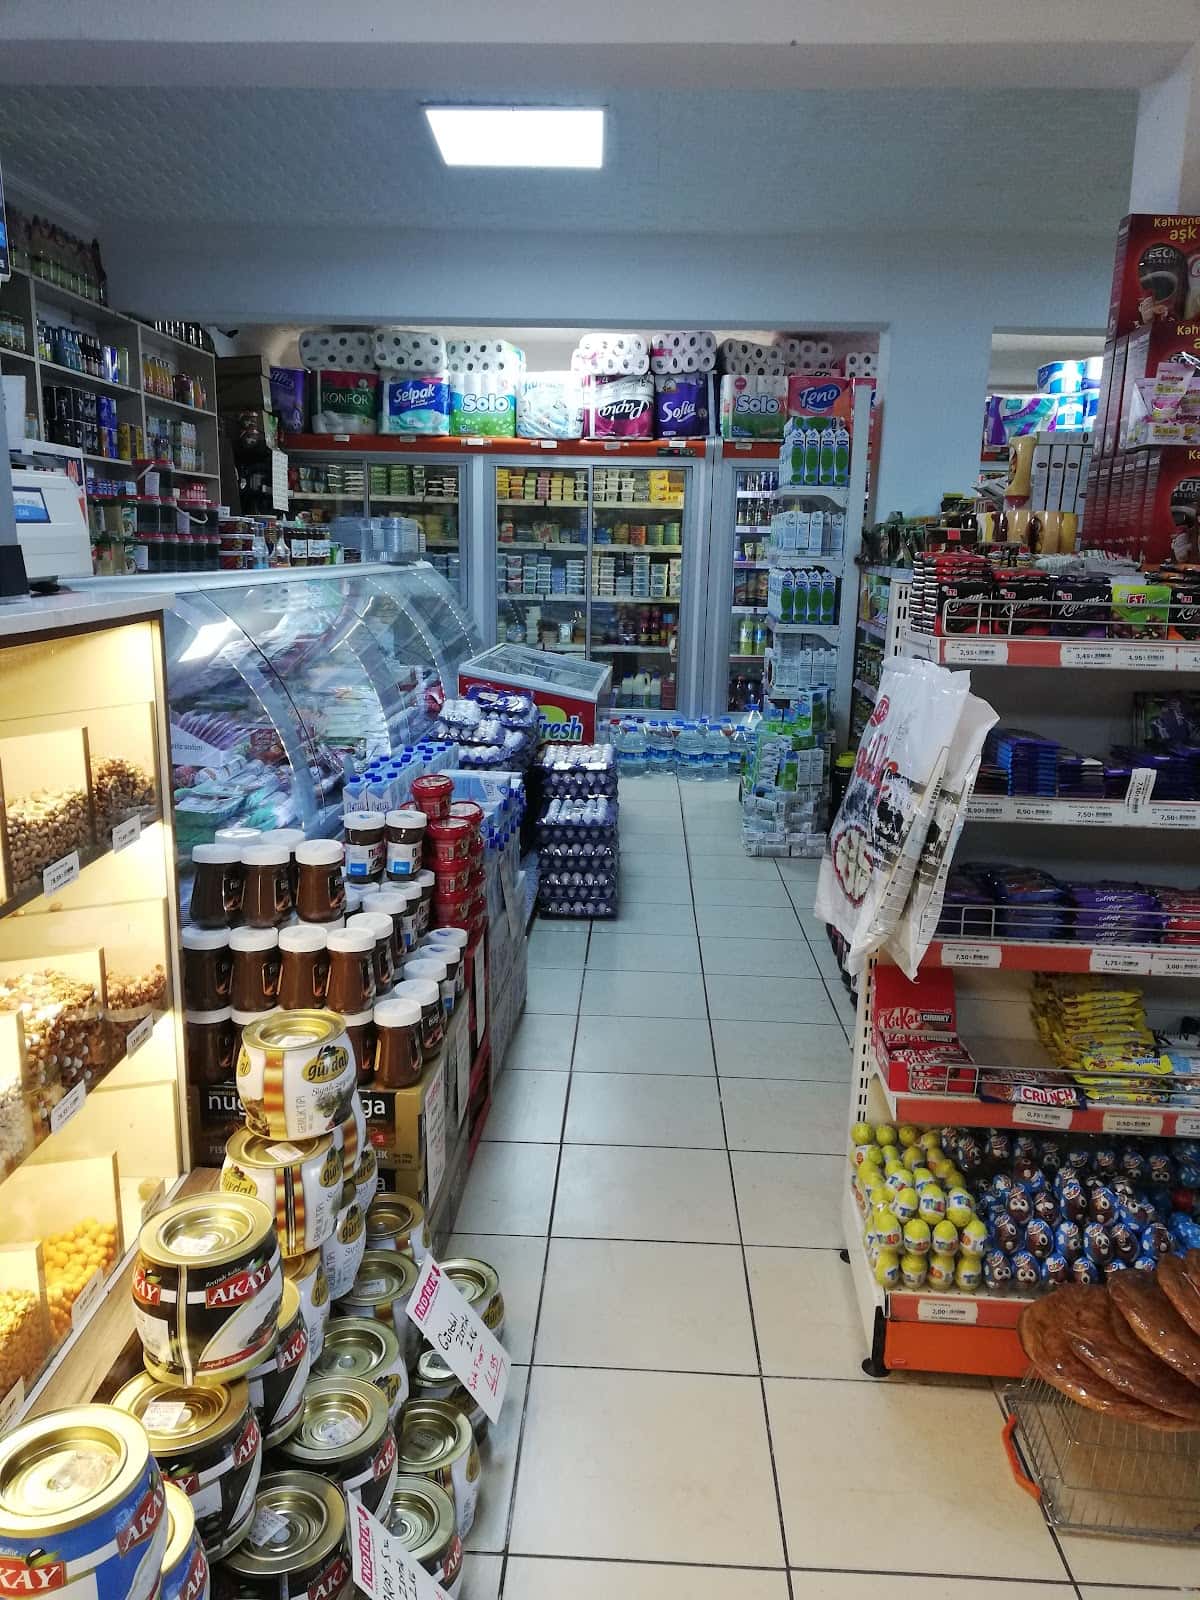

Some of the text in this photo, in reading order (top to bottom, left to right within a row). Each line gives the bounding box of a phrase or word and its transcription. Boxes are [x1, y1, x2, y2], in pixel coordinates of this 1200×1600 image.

[1169, 226, 1197, 243] aşk
[322, 391, 368, 405] KONFOR
[394, 384, 435, 403] Selpak
[463, 393, 509, 412] Solo
[660, 400, 697, 422] Sofia
[736, 395, 780, 413] Solo
[1021, 1087, 1076, 1106] CRUNCH
[210, 1264, 268, 1305] AKAY
